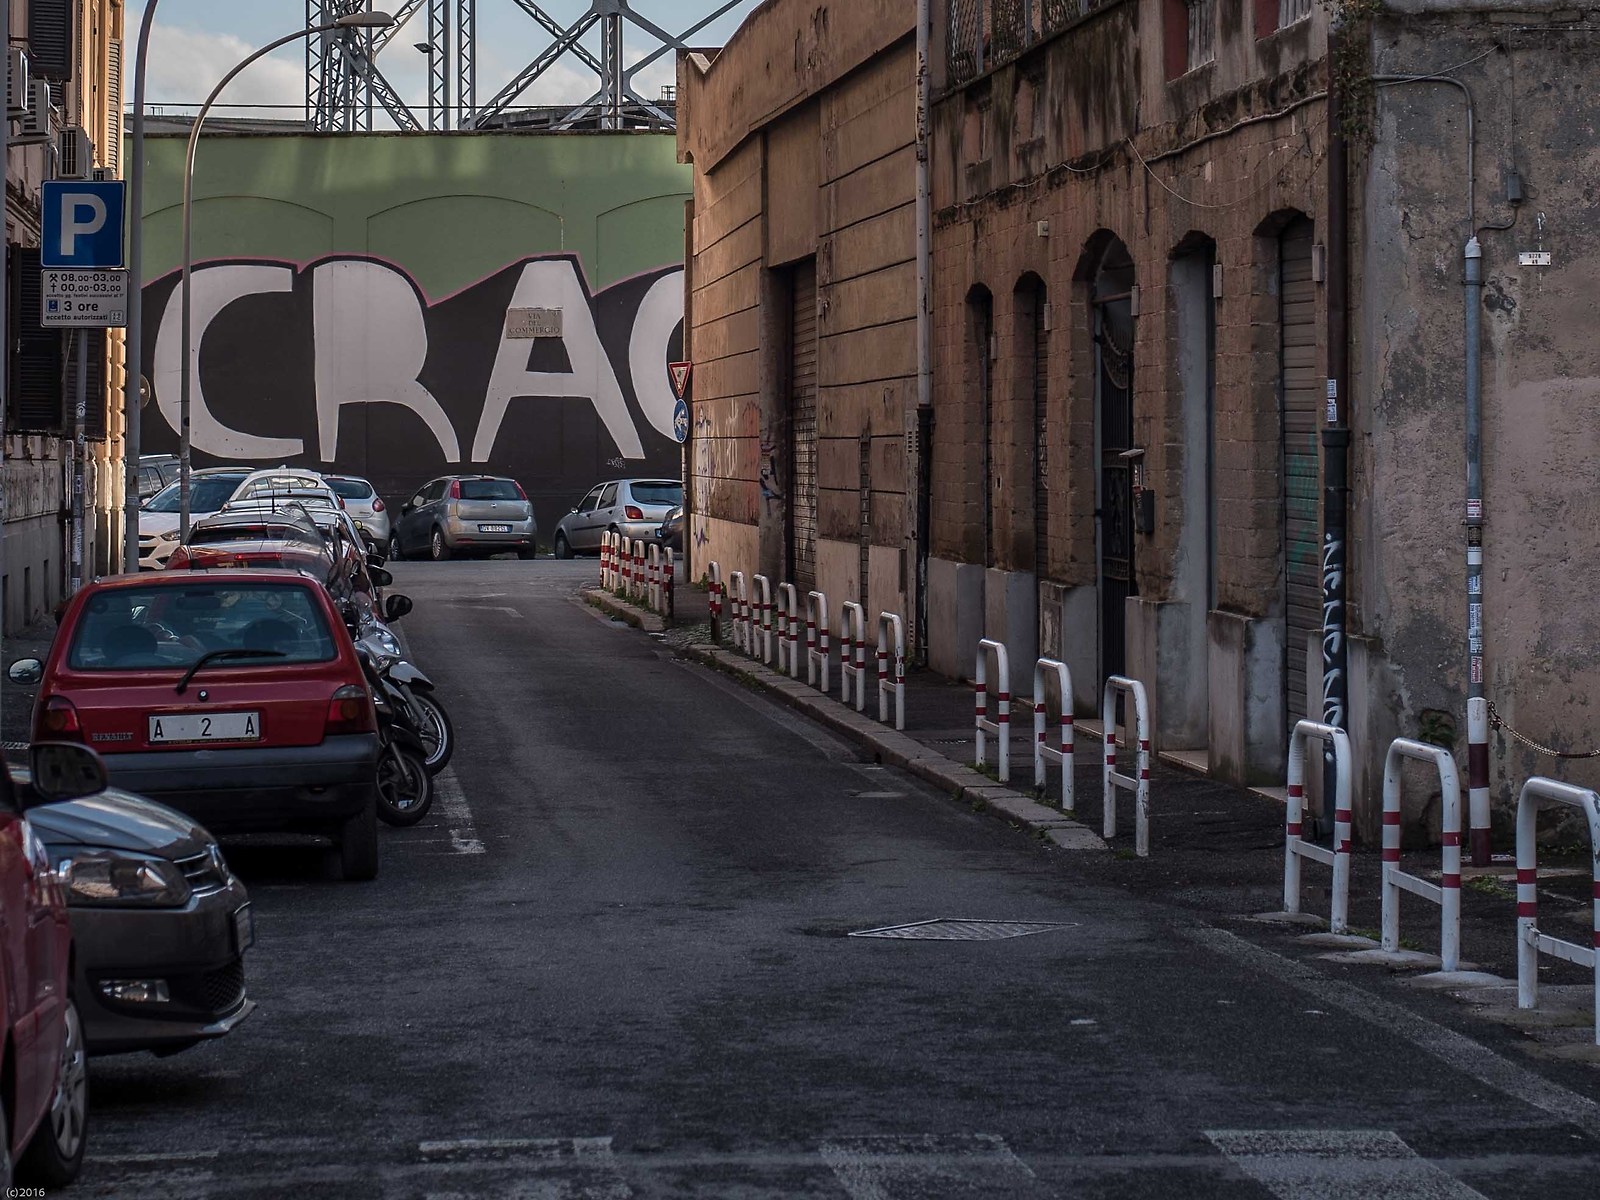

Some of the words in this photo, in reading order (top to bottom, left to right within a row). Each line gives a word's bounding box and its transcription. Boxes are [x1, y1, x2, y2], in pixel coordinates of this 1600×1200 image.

[61, 193, 107, 256] P
[64, 301, 72, 311] 3
[78, 303, 99, 311] ore
